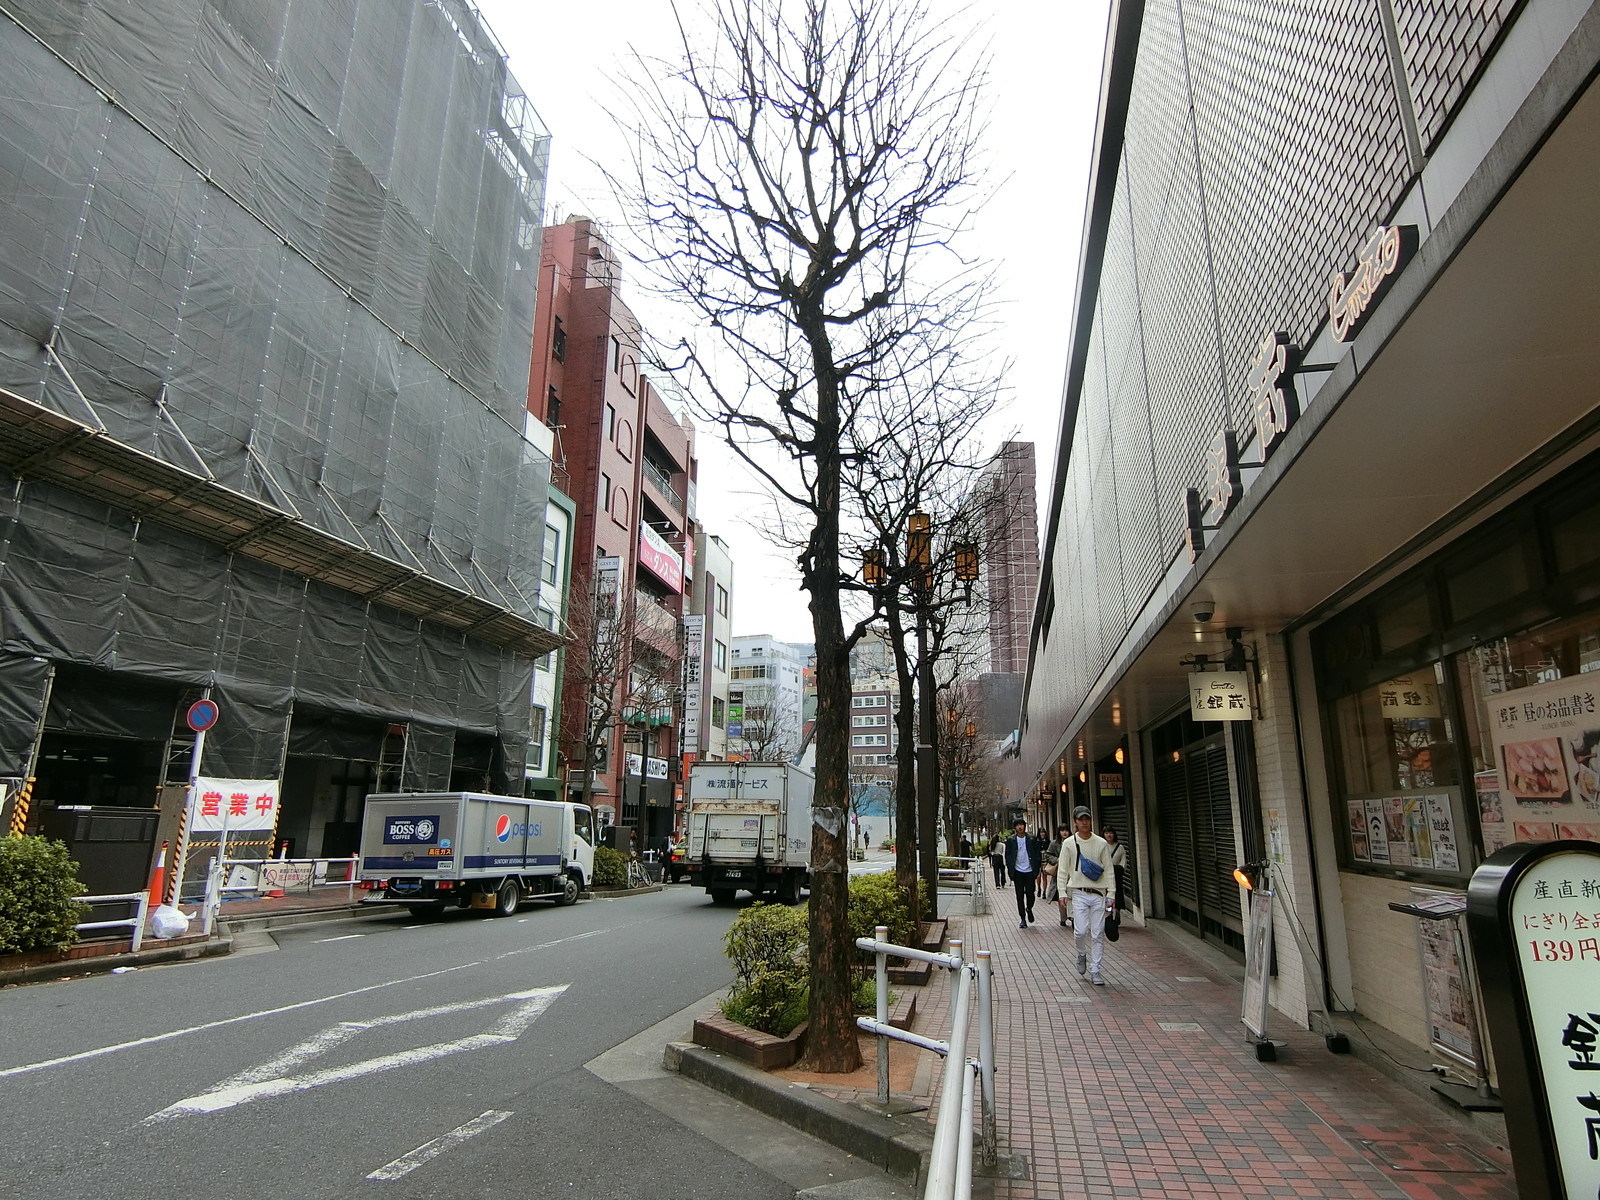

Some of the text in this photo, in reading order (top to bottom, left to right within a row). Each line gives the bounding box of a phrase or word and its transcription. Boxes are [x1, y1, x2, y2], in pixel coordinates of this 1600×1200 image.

[1207, 693, 1247, 710] 銀蔵
[1523, 692, 1596, 723] 昼のお品書き
[201, 791, 273, 817] 営業中
[389, 824, 415, 835] BOSS
[512, 821, 542, 840] pepsi
[1533, 879, 1600, 899] 産直新
[1529, 937, 1600, 962] 139円
